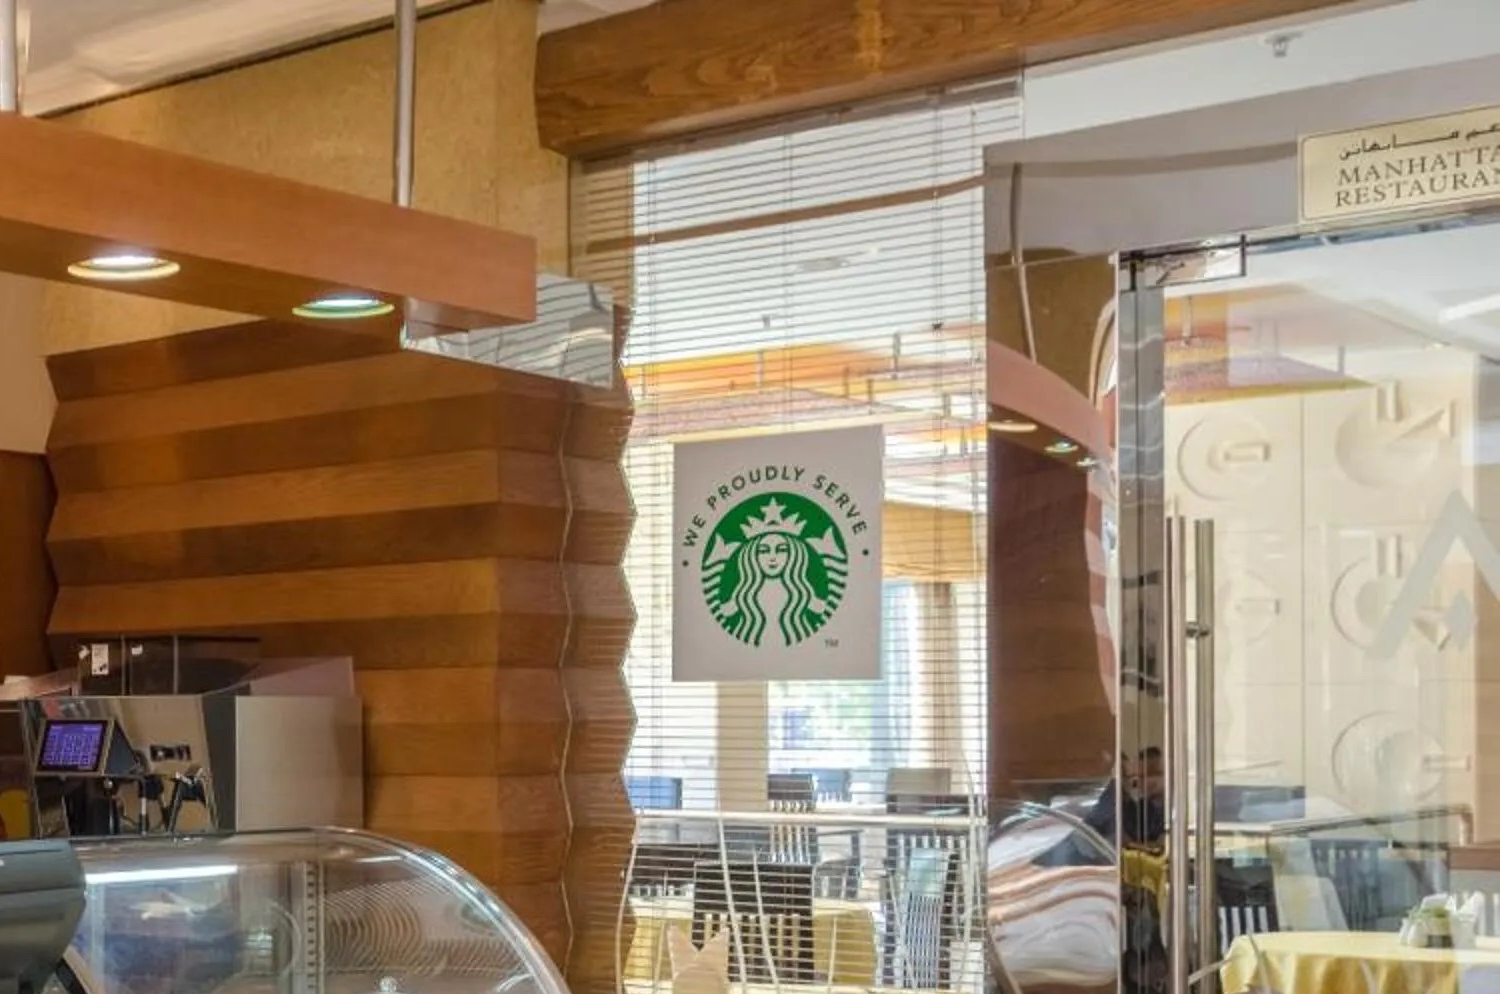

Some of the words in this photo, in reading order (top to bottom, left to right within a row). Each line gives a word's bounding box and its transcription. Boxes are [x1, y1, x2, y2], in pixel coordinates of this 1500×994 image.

[683, 515, 706, 548] WE
[707, 465, 806, 511] PROUDLY
[812, 474, 869, 535] SERVE
